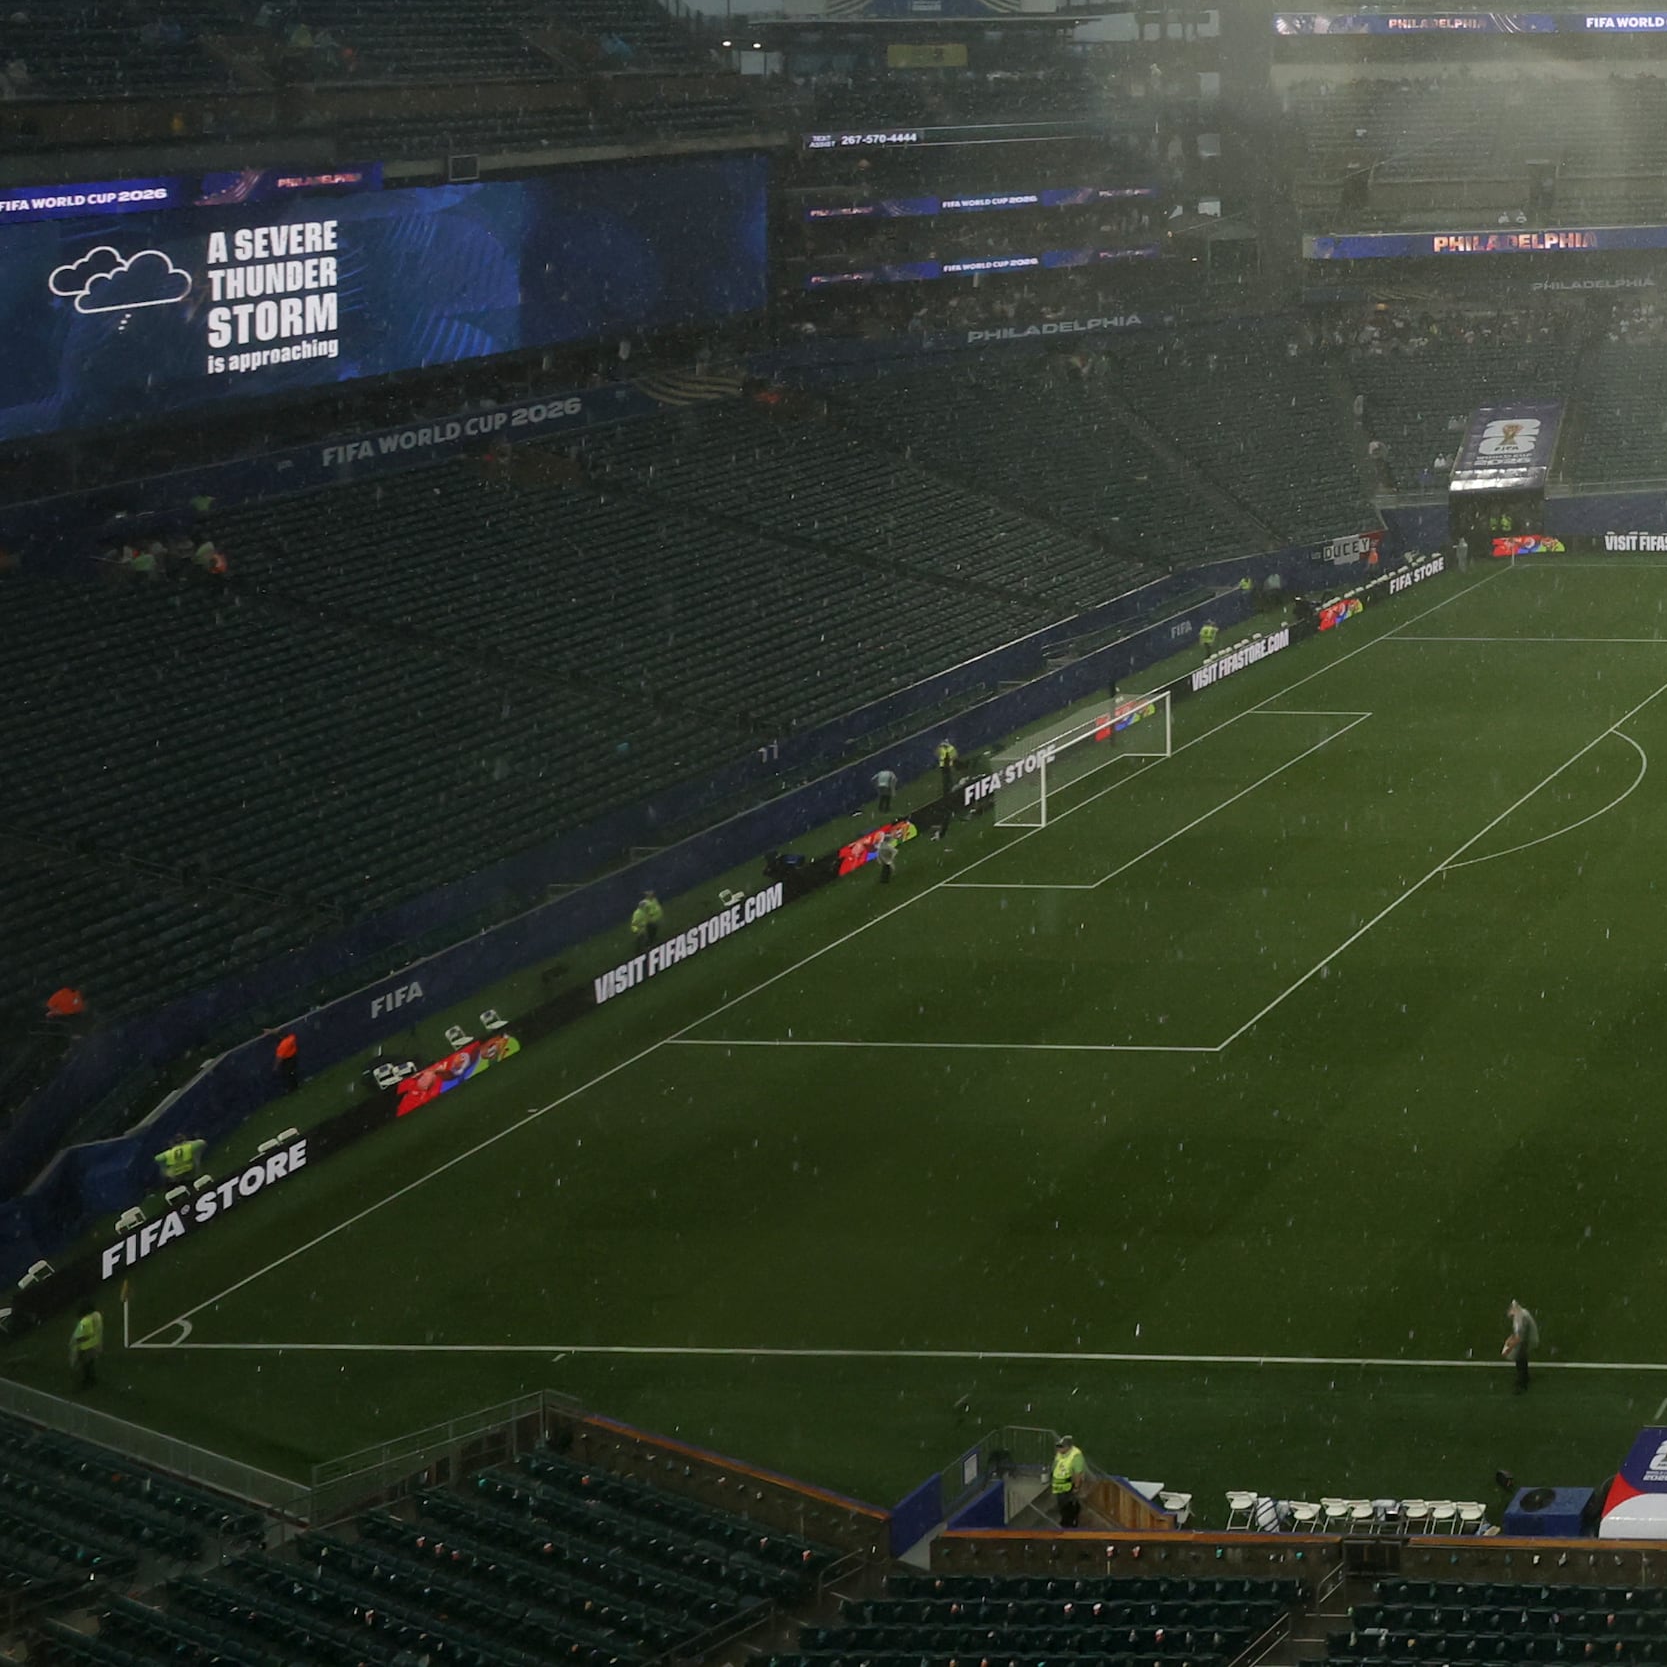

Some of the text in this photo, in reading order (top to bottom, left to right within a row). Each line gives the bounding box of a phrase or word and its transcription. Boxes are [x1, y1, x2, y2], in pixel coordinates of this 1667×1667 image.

[1586, 17, 1615, 29] FIFA
[1616, 16, 1665, 29] WORLD
[0, 187, 168, 212] FIFA WORLD CUP 2026
[207, 220, 338, 264] A SEVERE
[1433, 232, 1597, 252] PHILADELPHIA
[207, 257, 338, 301] THUNDER
[207, 292, 339, 349] STORM
[967, 314, 1142, 344] PHILADELPHIA
[207, 337, 339, 375] is approaching
[322, 397, 582, 467] FIFA WORLD CUP 2026
[1324, 538, 1370, 560] DUCEY
[1604, 534, 1637, 552] VISIT
[1414, 557, 1444, 583] STORE
[1170, 621, 1192, 638] FIFA
[1191, 629, 1290, 692] VISIT FIFASTORE.COM
[594, 882, 784, 1006] VISIT FIFASTORE.COM
[370, 981, 424, 1020] FIFA
[195, 1138, 308, 1224] STORE
